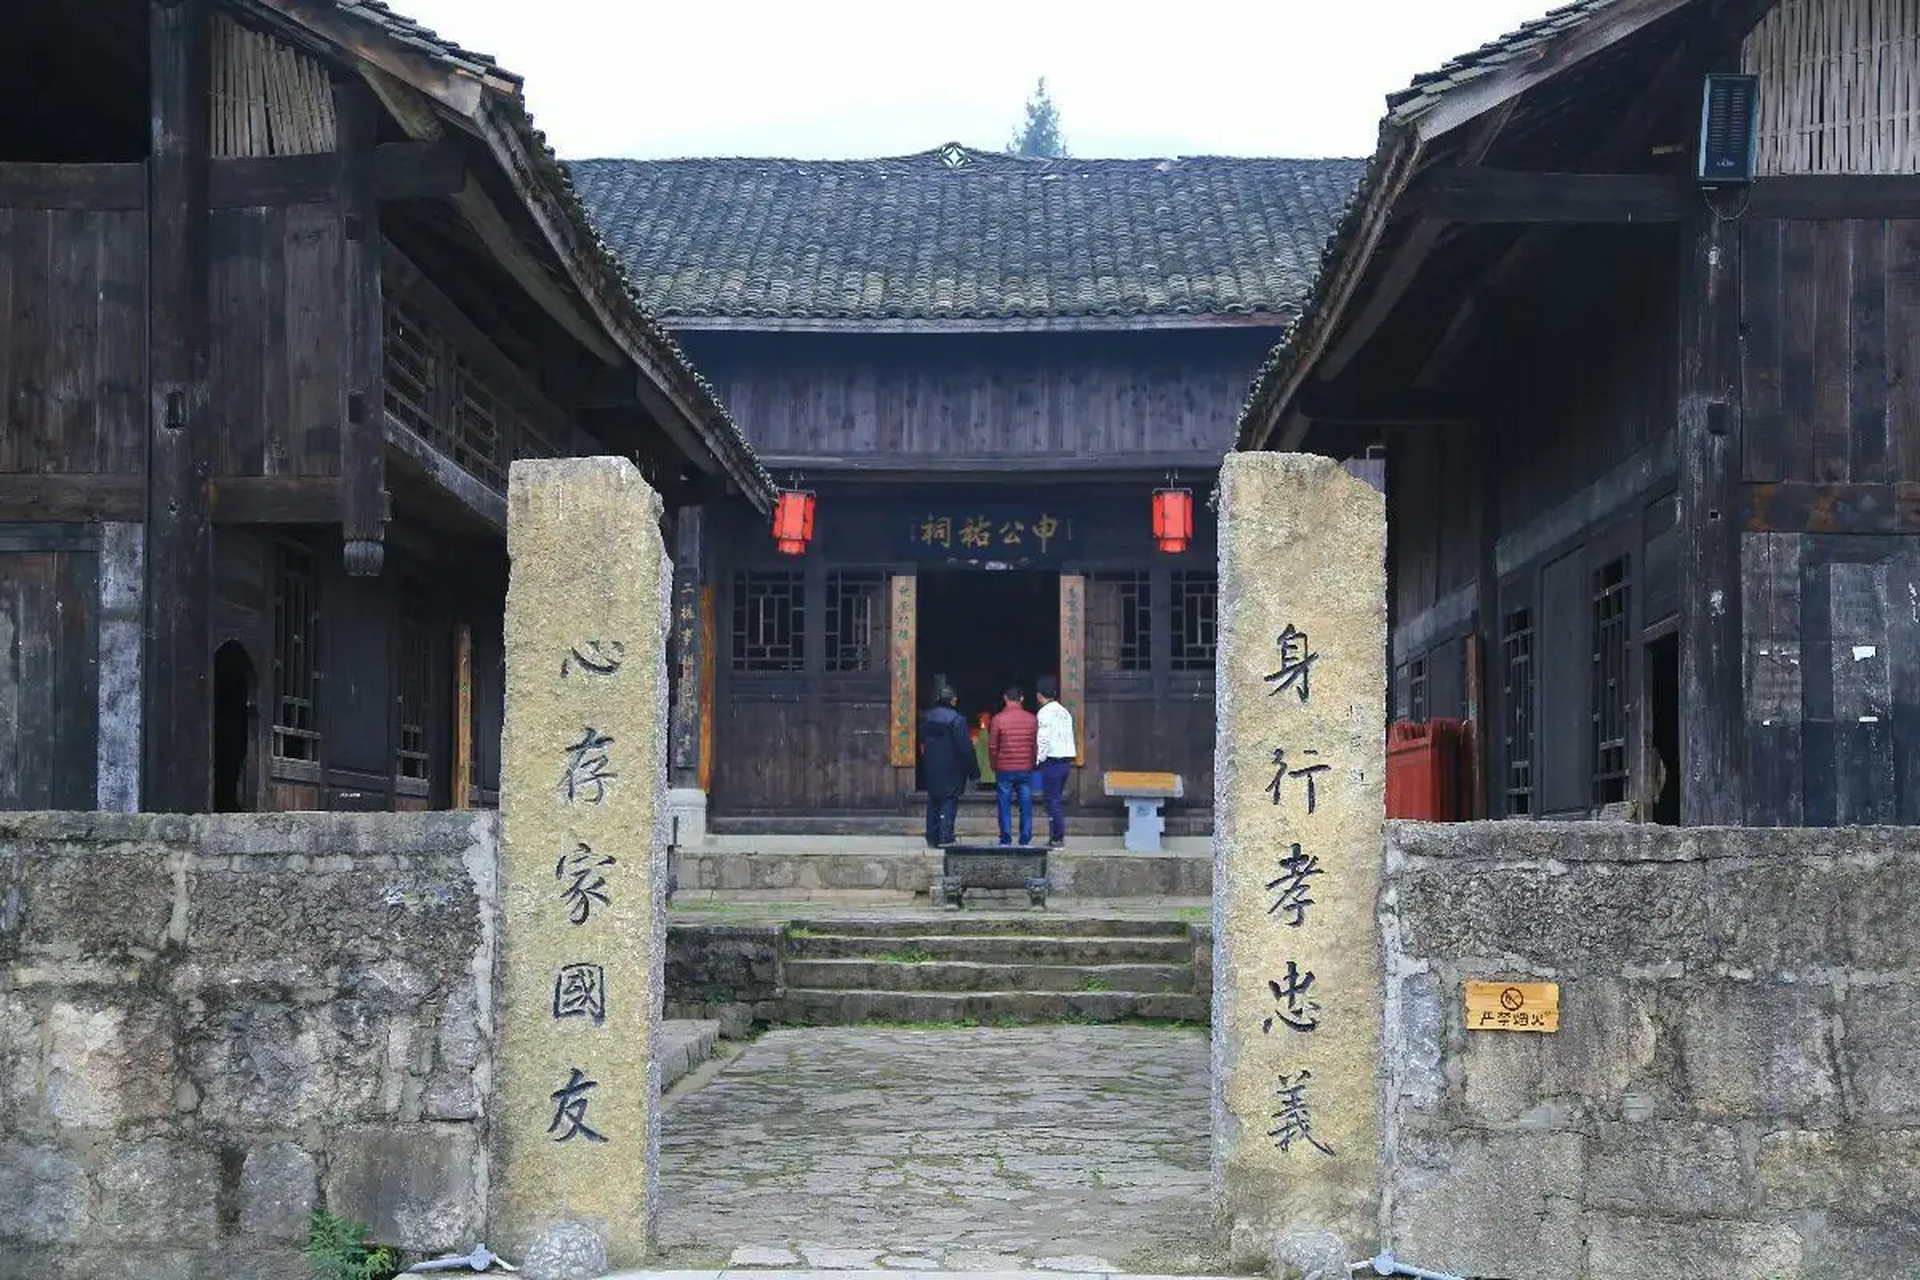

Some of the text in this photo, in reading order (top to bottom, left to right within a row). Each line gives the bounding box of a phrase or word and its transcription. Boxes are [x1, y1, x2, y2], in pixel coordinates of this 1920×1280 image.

[546, 639, 625, 1144] 心存家國友
[1263, 622, 1335, 1158] 身行孝忠義
[1479, 1010, 1545, 1027] 严禁烟火
